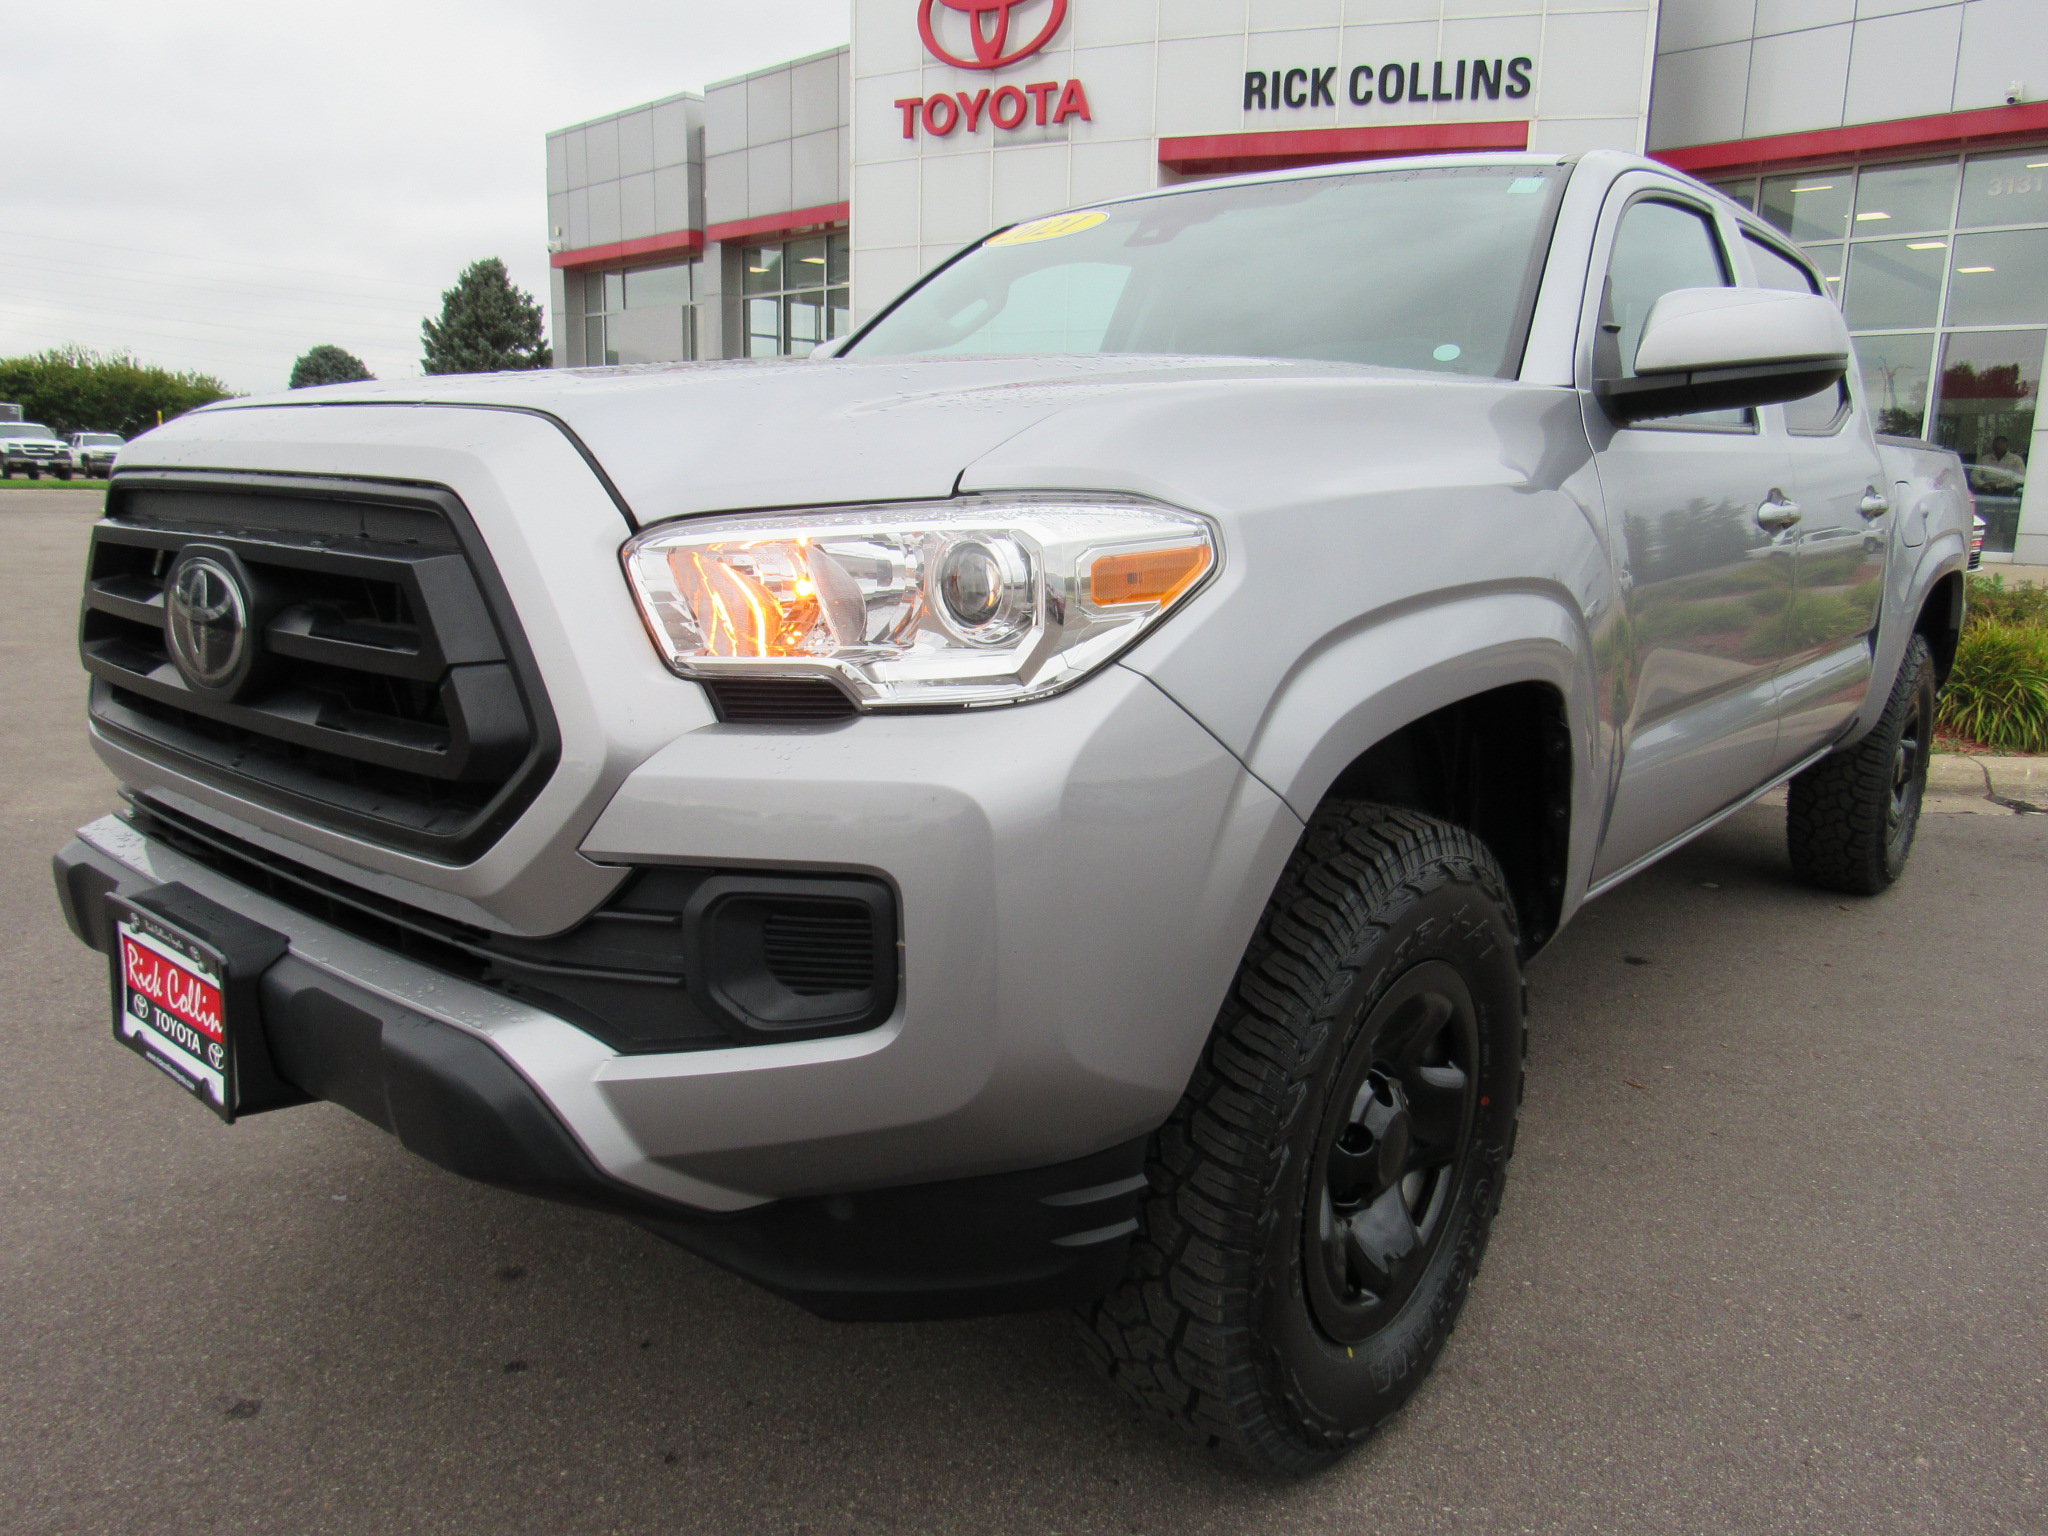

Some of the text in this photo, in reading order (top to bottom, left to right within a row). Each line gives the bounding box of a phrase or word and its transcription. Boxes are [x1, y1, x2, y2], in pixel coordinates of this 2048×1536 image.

[894, 78, 1092, 139] TOYOTA
[1243, 57, 1532, 110] RICK COLLINS
[127, 943, 223, 1034] Rick Collin
[153, 1007, 202, 1055] TOYOTA
